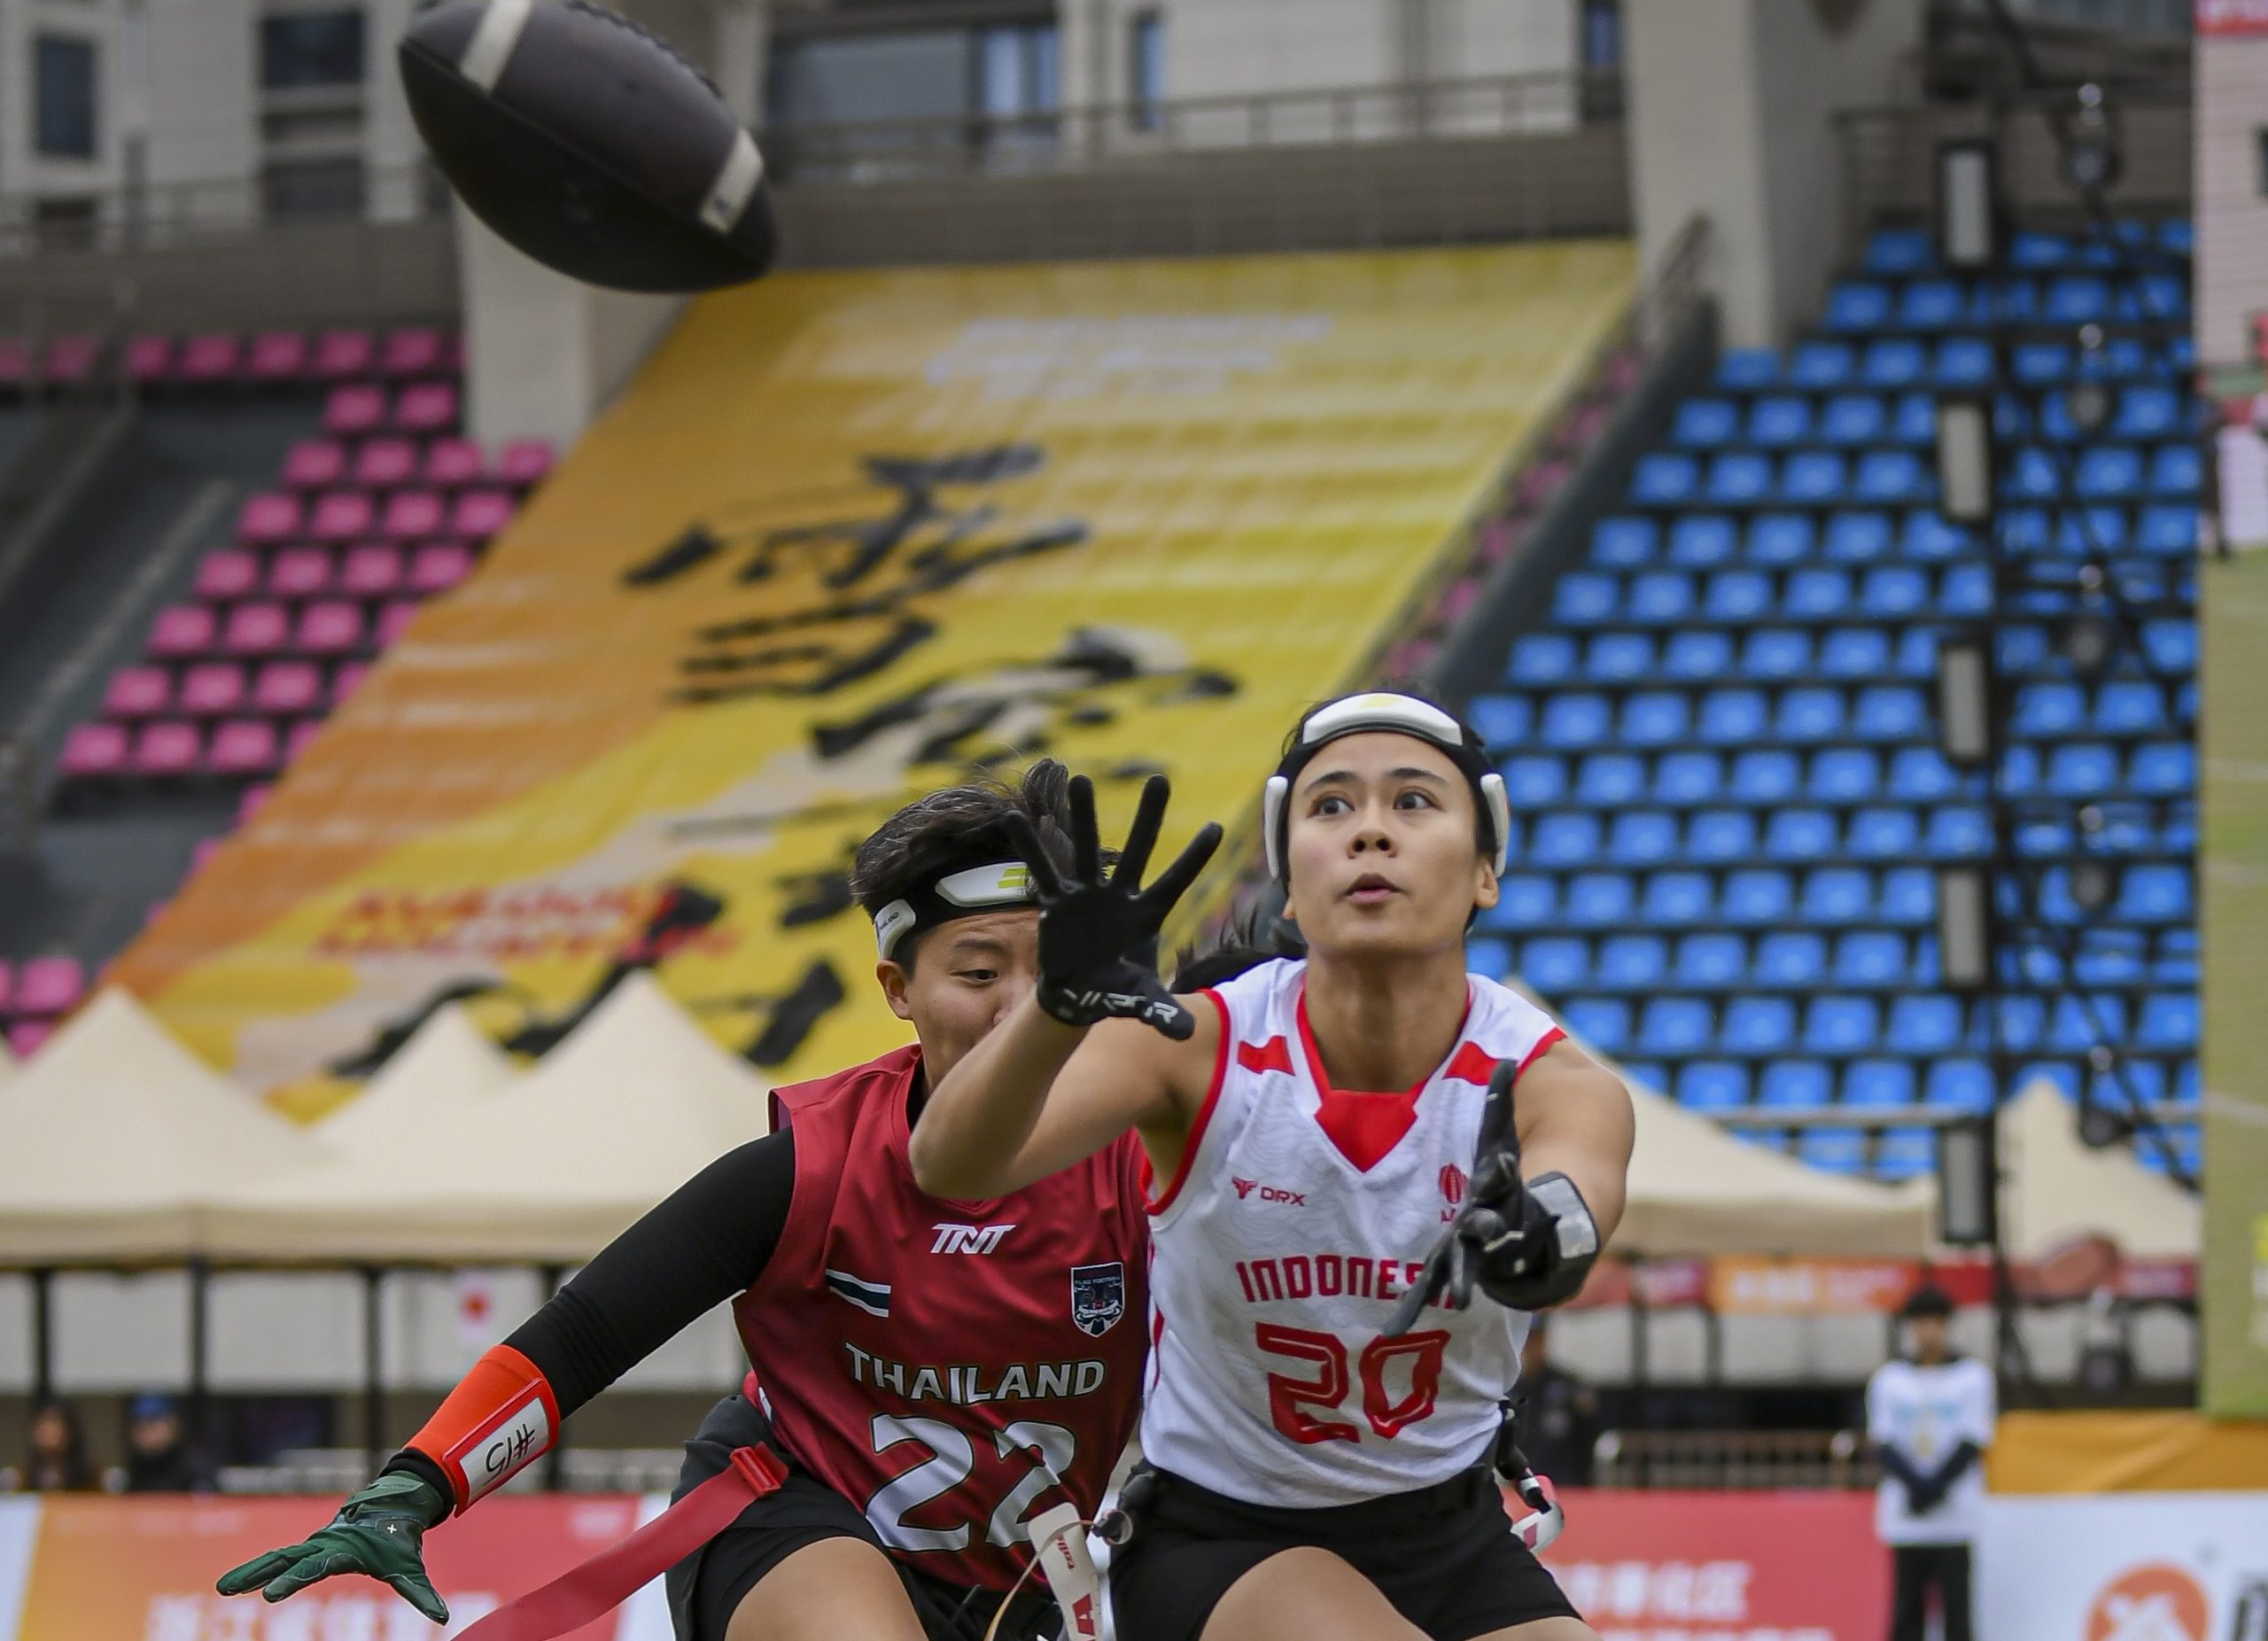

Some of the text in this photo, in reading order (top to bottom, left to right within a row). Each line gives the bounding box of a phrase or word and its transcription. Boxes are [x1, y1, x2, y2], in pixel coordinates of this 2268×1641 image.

[1260, 1186, 1306, 1207] DRX
[930, 1223, 1016, 1255] TNT
[843, 1341, 1107, 1405] THAILAND
[1254, 1321, 1451, 1444] 20
[865, 1413, 1076, 1552] 22
